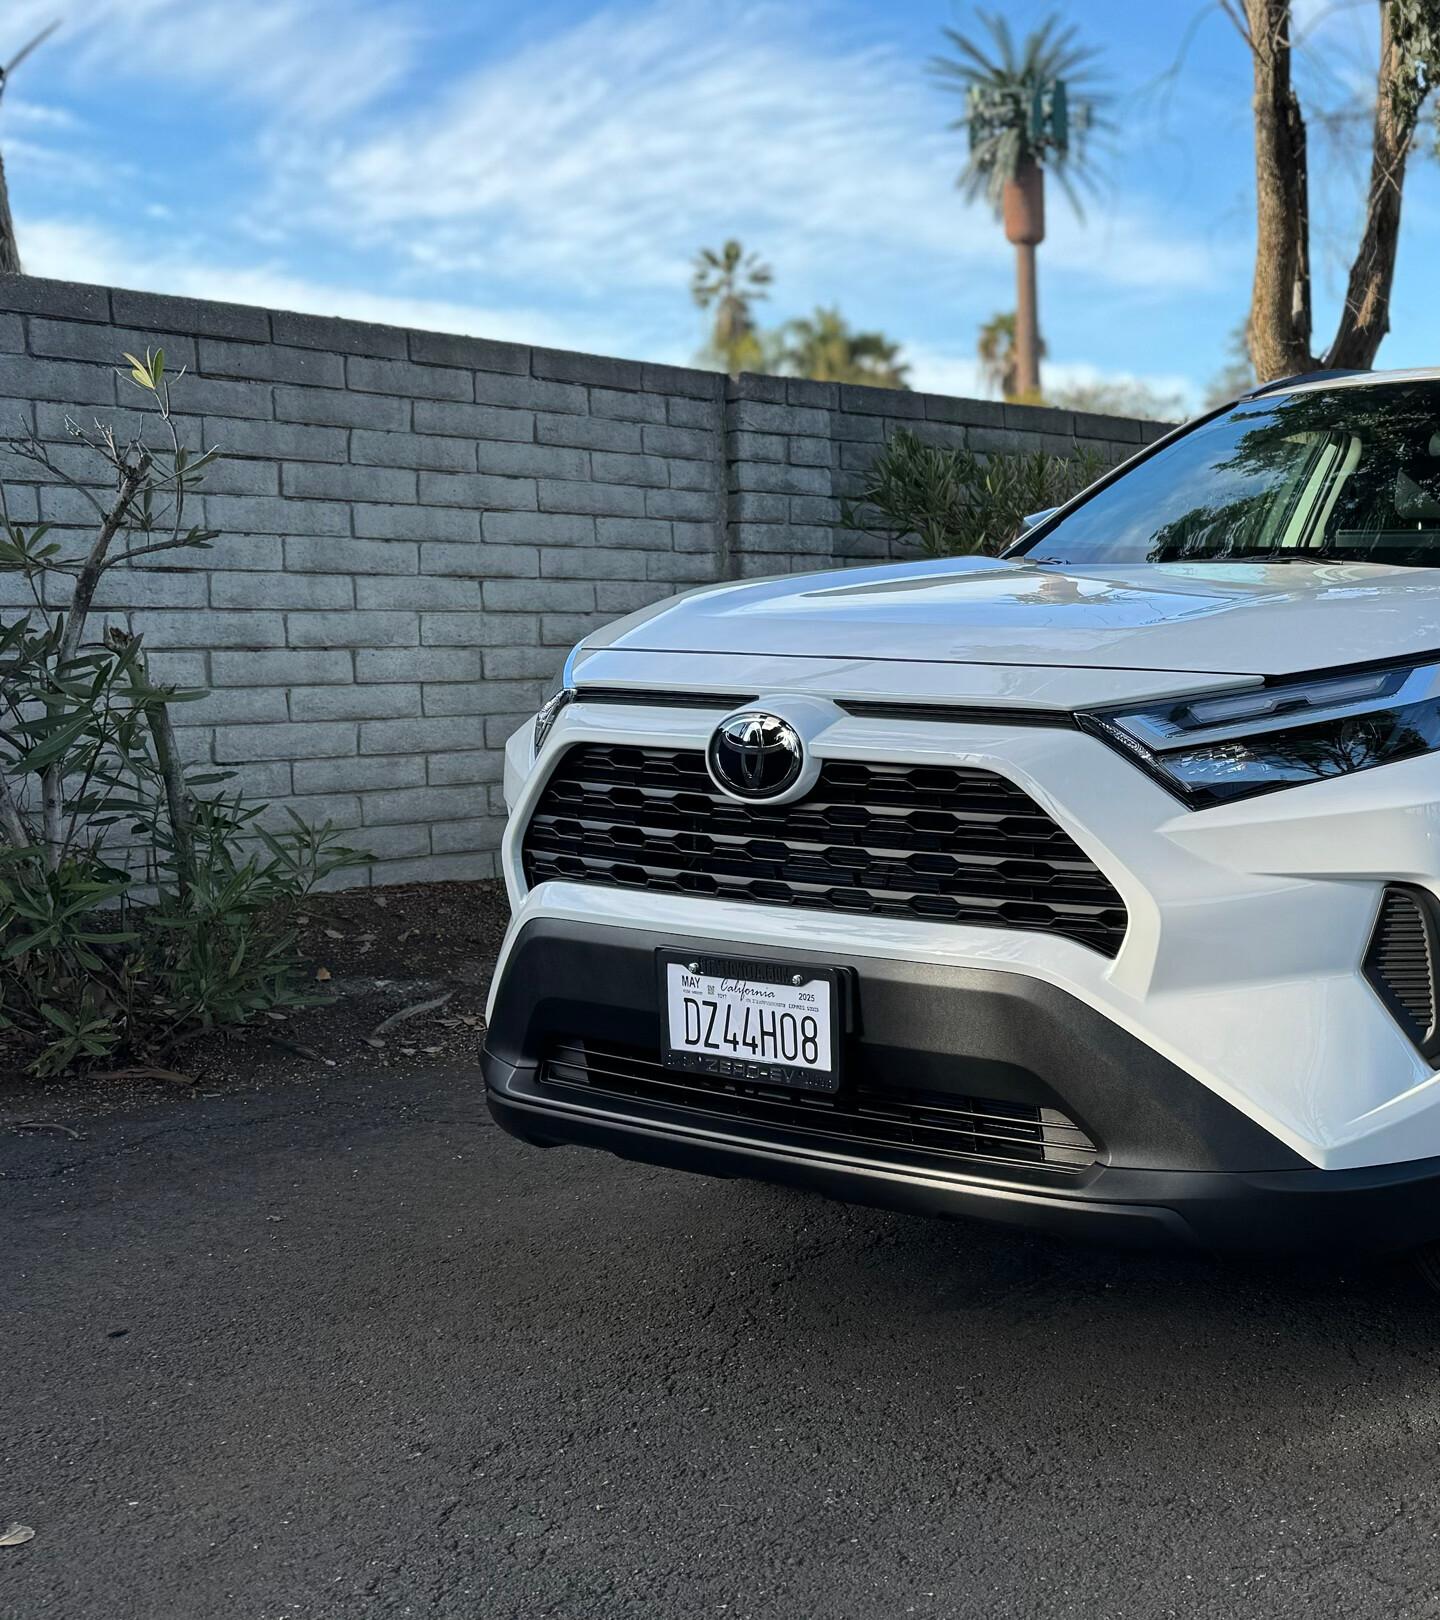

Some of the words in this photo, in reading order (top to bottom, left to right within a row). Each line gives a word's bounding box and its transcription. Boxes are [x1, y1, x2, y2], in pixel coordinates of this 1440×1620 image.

[681, 975, 701, 989] MAY
[720, 977, 776, 1001] California
[798, 992, 816, 1003] 2025
[683, 997, 818, 1065] DZ44H08
